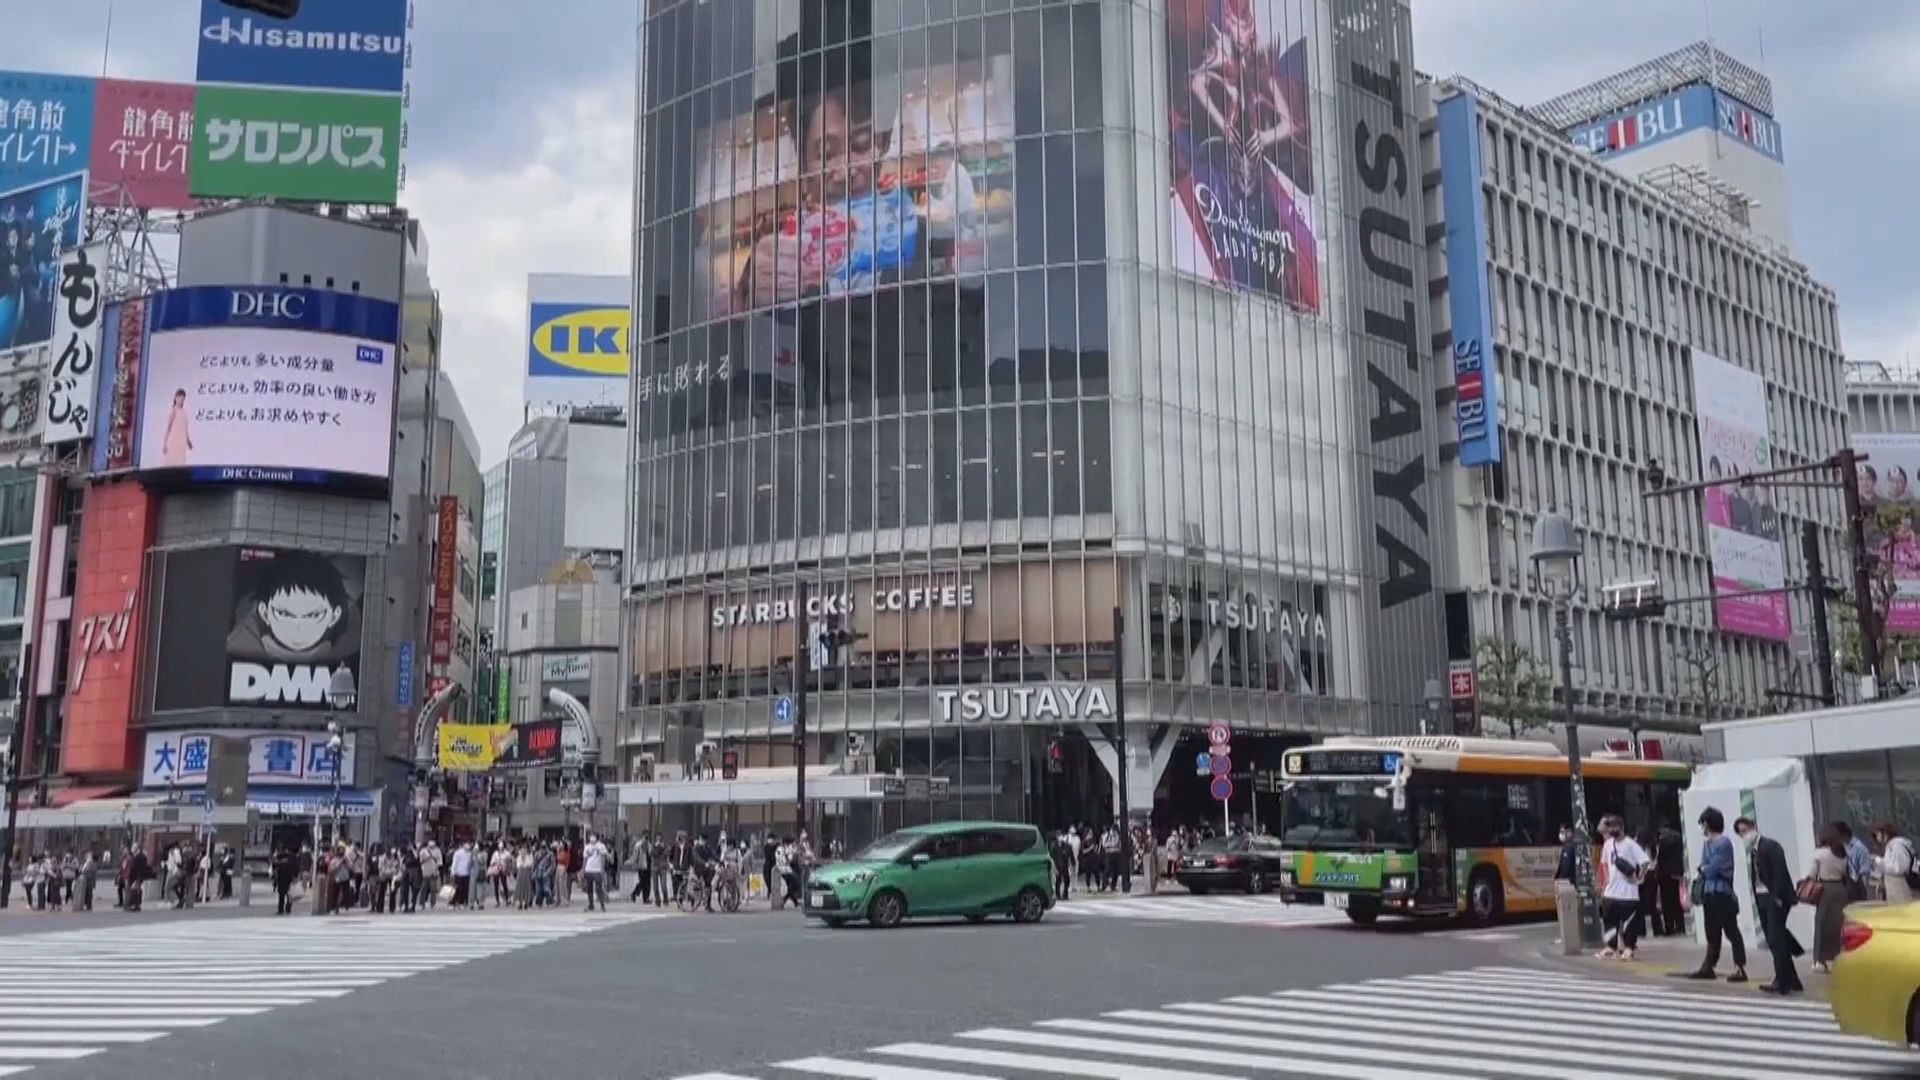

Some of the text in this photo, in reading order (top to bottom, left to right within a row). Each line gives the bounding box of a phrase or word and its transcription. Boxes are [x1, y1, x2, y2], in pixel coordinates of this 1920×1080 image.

[203, 17, 401, 54] Hisamitsu
[204, 117, 386, 169] サロンパス
[1571, 98, 1684, 152] SEIBU
[1717, 99, 1777, 158] SEIBU
[231, 291, 304, 318] DHC
[46, 248, 99, 434] もんじゃ
[550, 325, 629, 353] IK
[1350, 59, 1433, 610] TSUTAYA
[1455, 339, 1488, 443] SEIBU
[222, 467, 294, 481] DHC Channel
[871, 585, 974, 611] COFFEE
[1208, 600, 1326, 640] TSUTAYA
[72, 588, 136, 694] クスリ
[937, 686, 1112, 723] TSUTAYA
